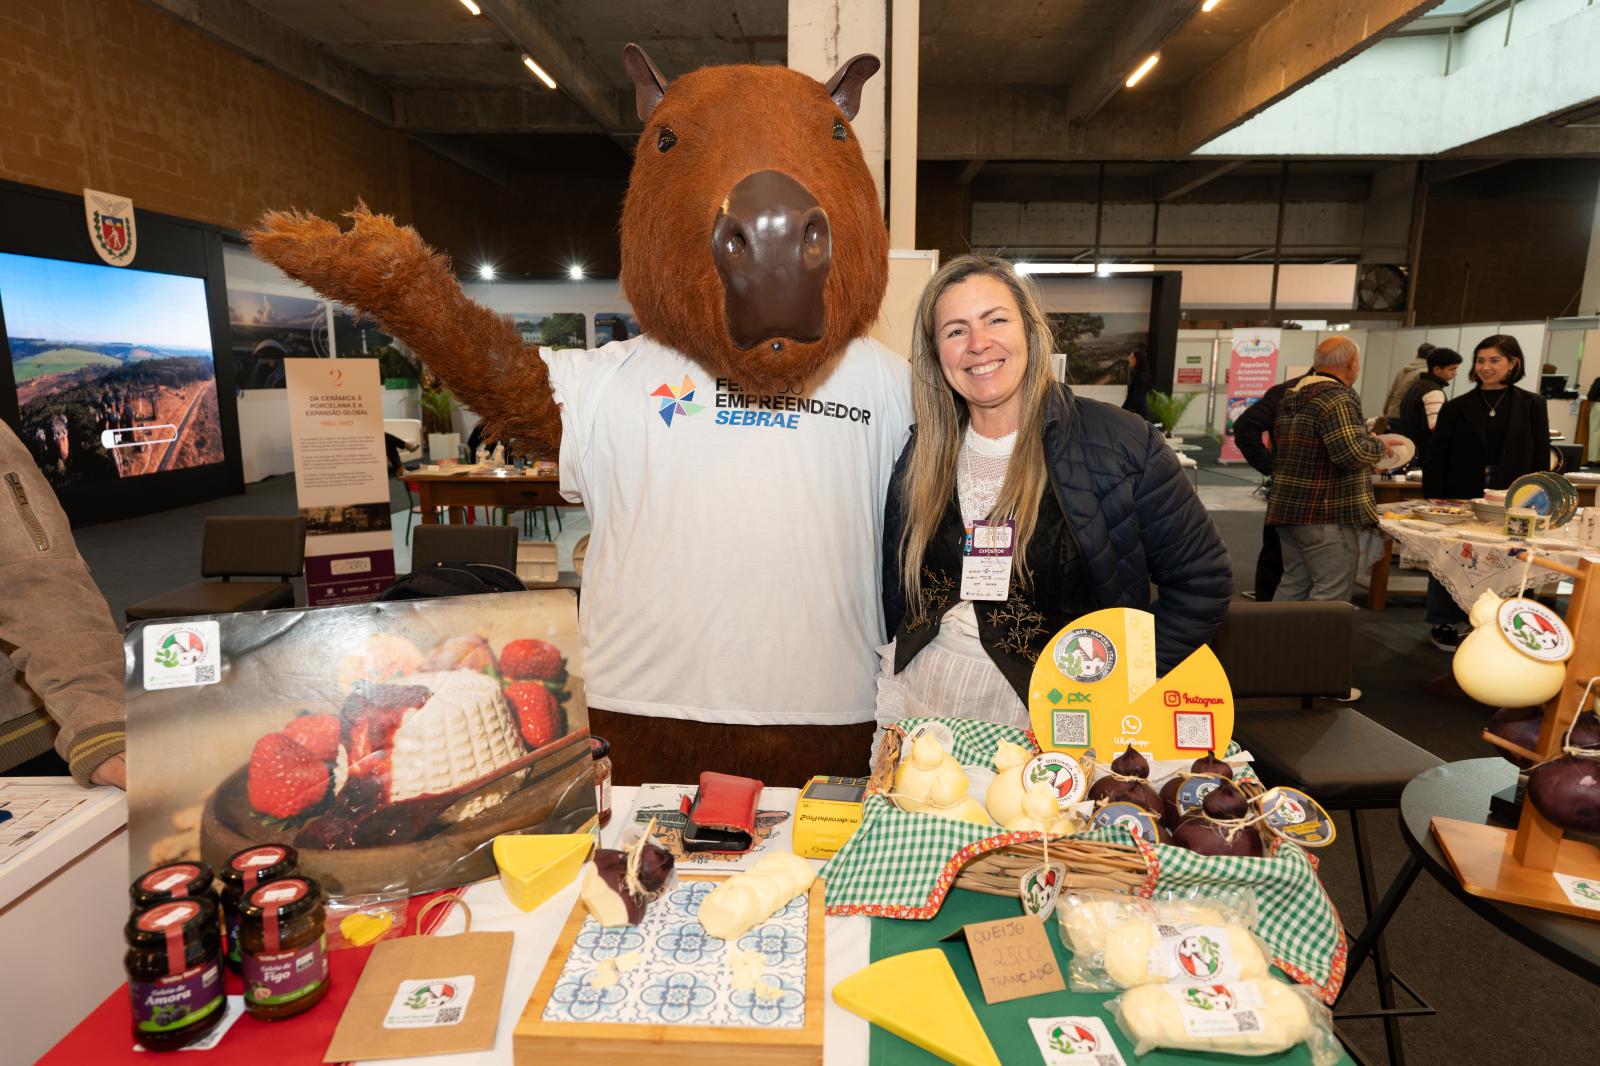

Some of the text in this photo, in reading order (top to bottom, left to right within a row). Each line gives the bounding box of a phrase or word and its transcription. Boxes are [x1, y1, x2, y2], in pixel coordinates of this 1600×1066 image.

[329, 369, 343, 387] 2
[715, 393, 872, 426] EMPREENDEDOR
[715, 410, 801, 430] SEBRAE
[1182, 692, 1225, 708] Instagram
[974, 922, 1024, 944] QUEIJO
[263, 970, 292, 984] Figo
[144, 989, 192, 1005] Amora
